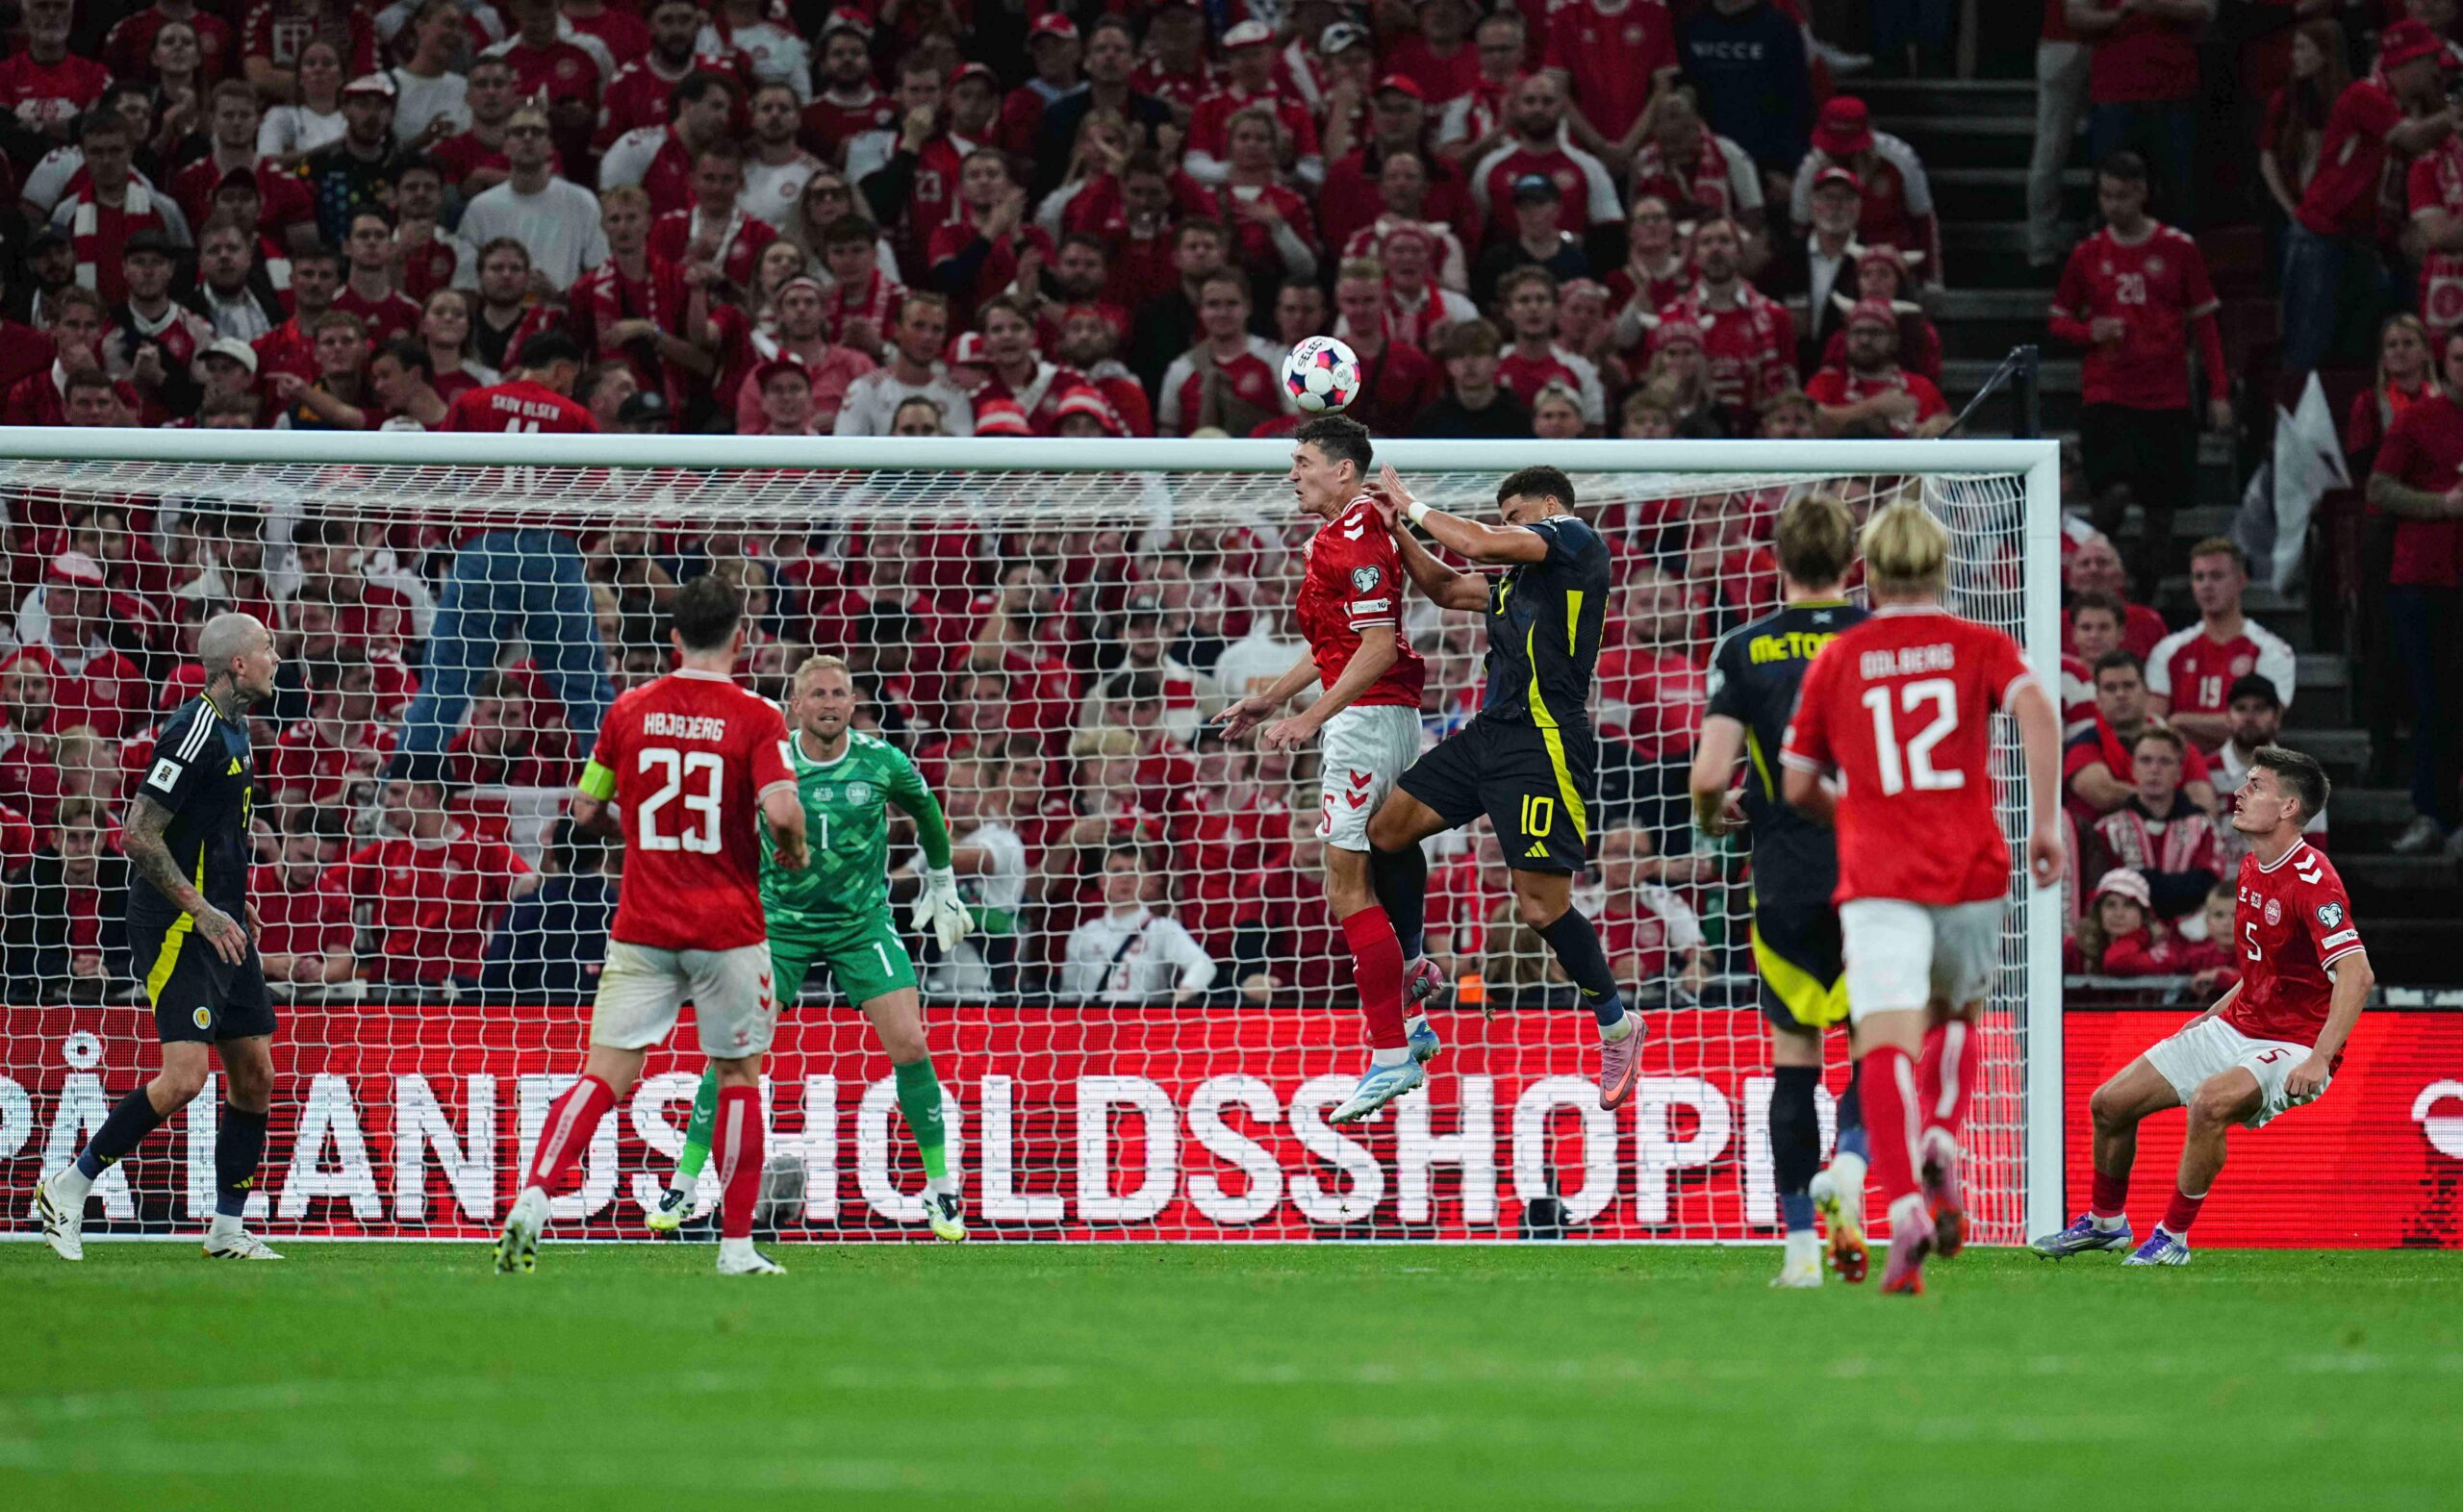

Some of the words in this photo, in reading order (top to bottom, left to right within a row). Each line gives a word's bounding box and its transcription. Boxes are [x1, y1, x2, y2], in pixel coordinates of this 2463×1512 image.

[1862, 678, 1965, 797] 12
[242, 786, 252, 828] 9
[639, 747, 724, 854] 23
[1521, 794, 1555, 837] 10
[819, 813, 828, 849] 1
[873, 942, 894, 977] 1
[2246, 921, 2262, 961] 5
[2255, 1047, 2292, 1065] 5
